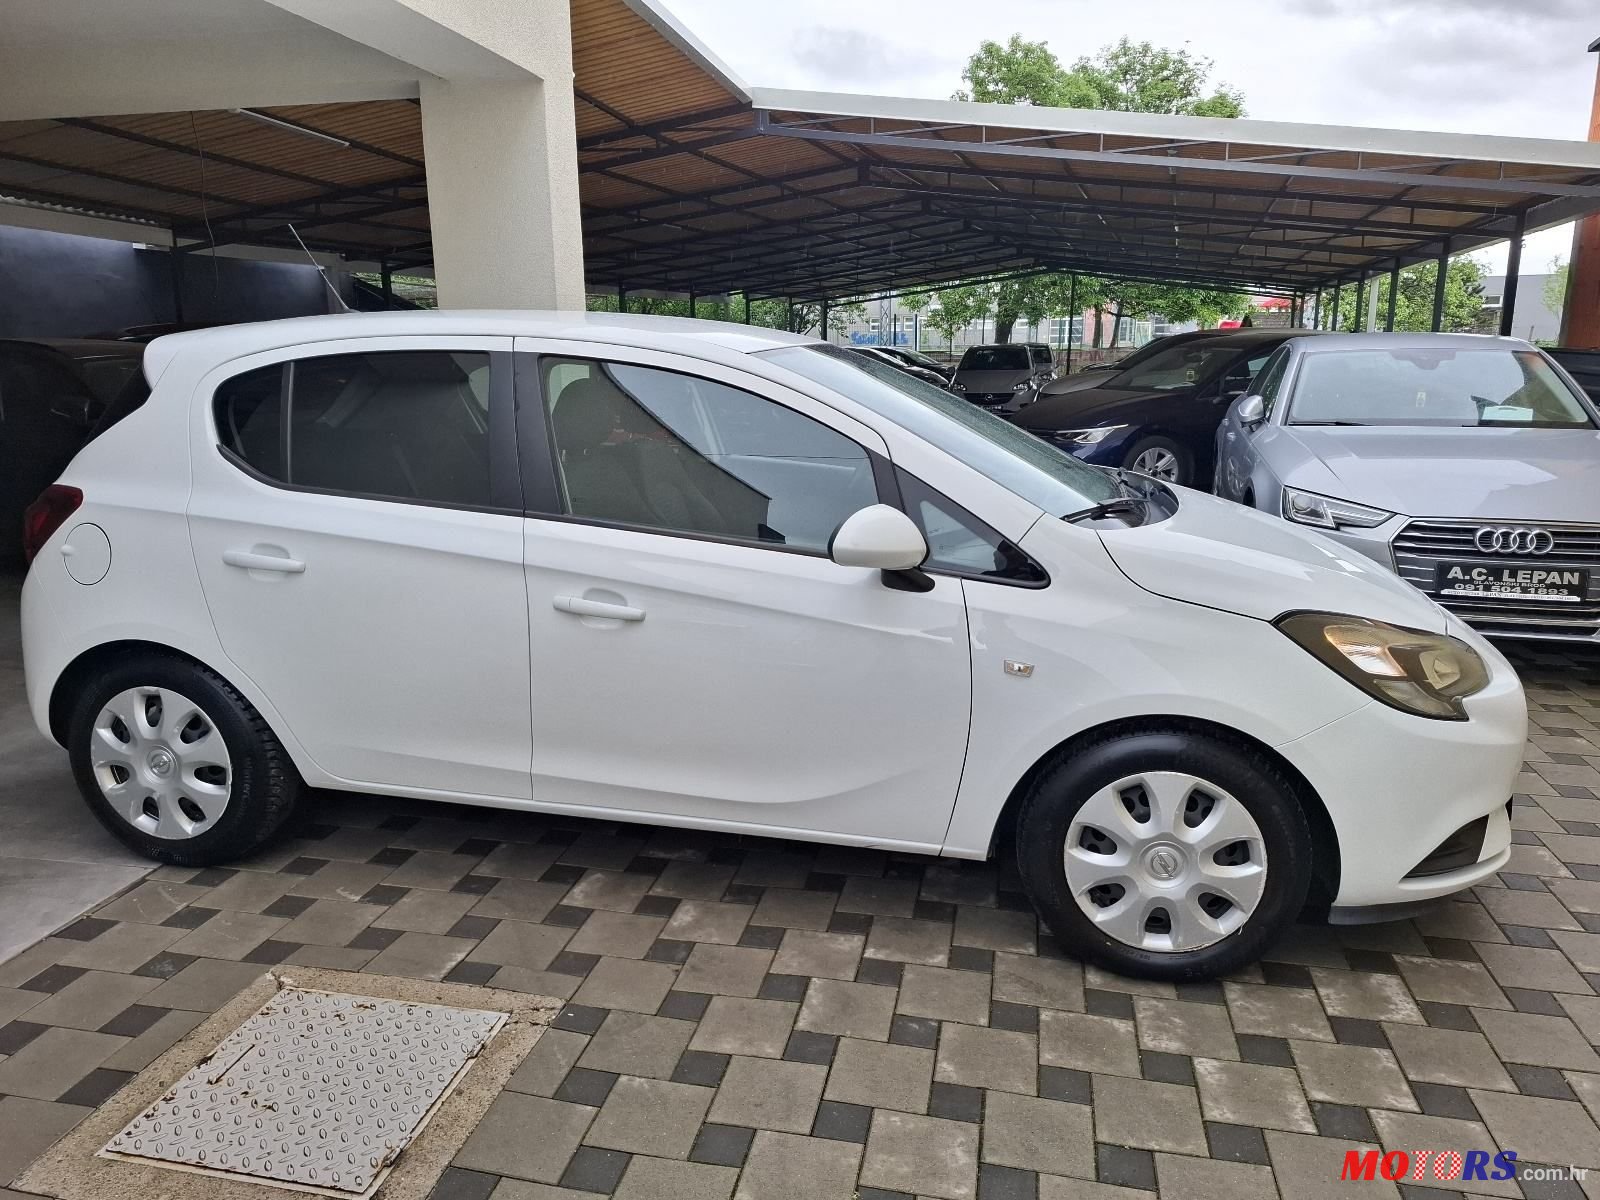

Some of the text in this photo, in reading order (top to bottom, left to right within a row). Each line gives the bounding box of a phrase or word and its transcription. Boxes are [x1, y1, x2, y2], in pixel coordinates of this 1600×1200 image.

[1446, 566, 1580, 585] A.C. LEPAN
[1454, 583, 1484, 592] 091
[1490, 585, 1522, 594] 504
[1527, 587, 1569, 596] 1893
